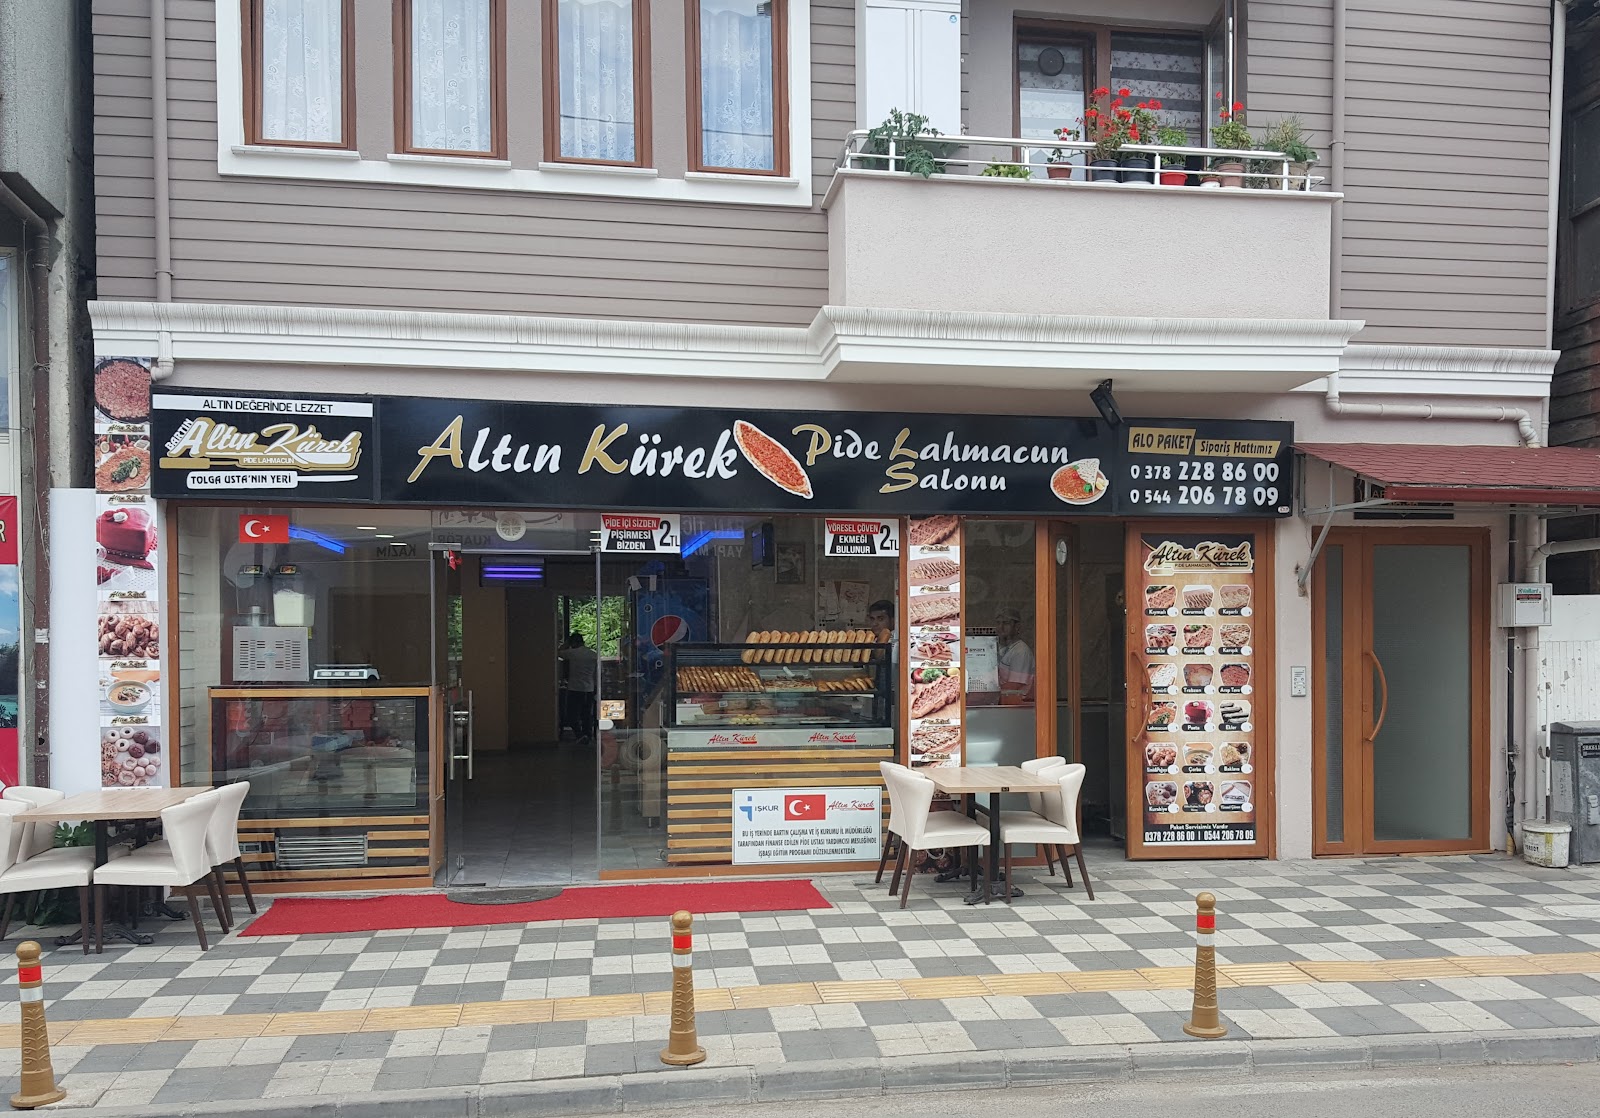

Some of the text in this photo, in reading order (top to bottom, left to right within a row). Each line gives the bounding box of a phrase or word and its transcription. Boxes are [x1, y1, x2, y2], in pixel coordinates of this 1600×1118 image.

[202, 399, 334, 414] ALTIN DEĞERİNDE LEZZET
[164, 418, 192, 451] BARTIN
[170, 419, 359, 458] Altın Kürek
[407, 415, 738, 484] Altın Kürek
[792, 424, 1068, 466] Pide Lahmacun
[1132, 433, 1272, 456] ALO PAKET Sipariş Hattımız
[190, 475, 220, 485] TOLGA
[270, 472, 292, 484] YERİ
[879, 461, 1006, 494] Salonu
[1130, 461, 1280, 482] 0 378 228 86 00
[1130, 486, 1279, 506] 0 544 206 78 09
[605, 518, 656, 528] PİDE İÇİ SİZDEN
[828, 523, 878, 534] YÖRESEL ÇÖVEN
[611, 530, 651, 540] PİŞİRMESİ
[839, 534, 868, 544] EKMEĞİ
[616, 540, 646, 550] BİZDEN
[836, 545, 870, 554] BULUNUR
[1148, 544, 1248, 566] Altın Kürek
[1145, 830, 1254, 841] 0378 228 86 00 0544 206 78 09
